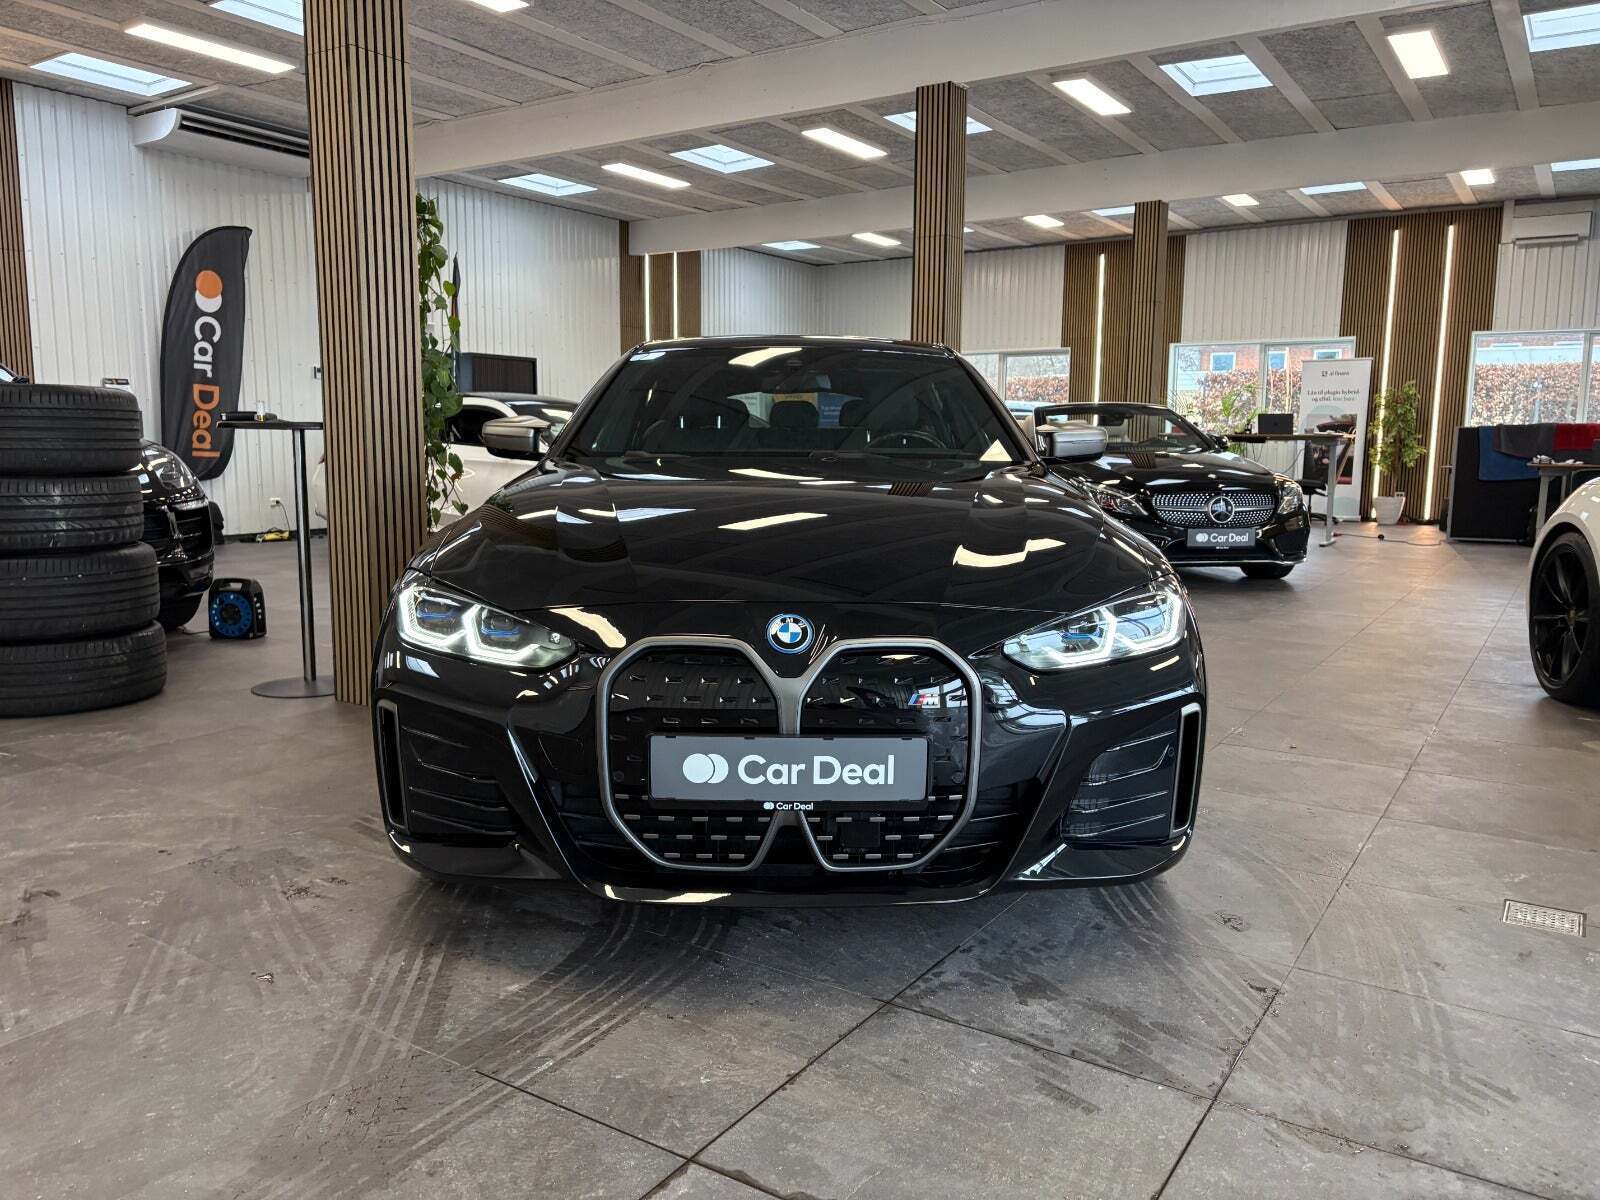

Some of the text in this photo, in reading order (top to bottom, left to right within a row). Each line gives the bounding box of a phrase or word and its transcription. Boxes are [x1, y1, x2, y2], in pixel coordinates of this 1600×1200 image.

[192, 316, 221, 458] Car Deal
[1210, 532, 1249, 543] Car Deal
[737, 754, 895, 785] Car Deal
[776, 802, 814, 811] Car Deal
